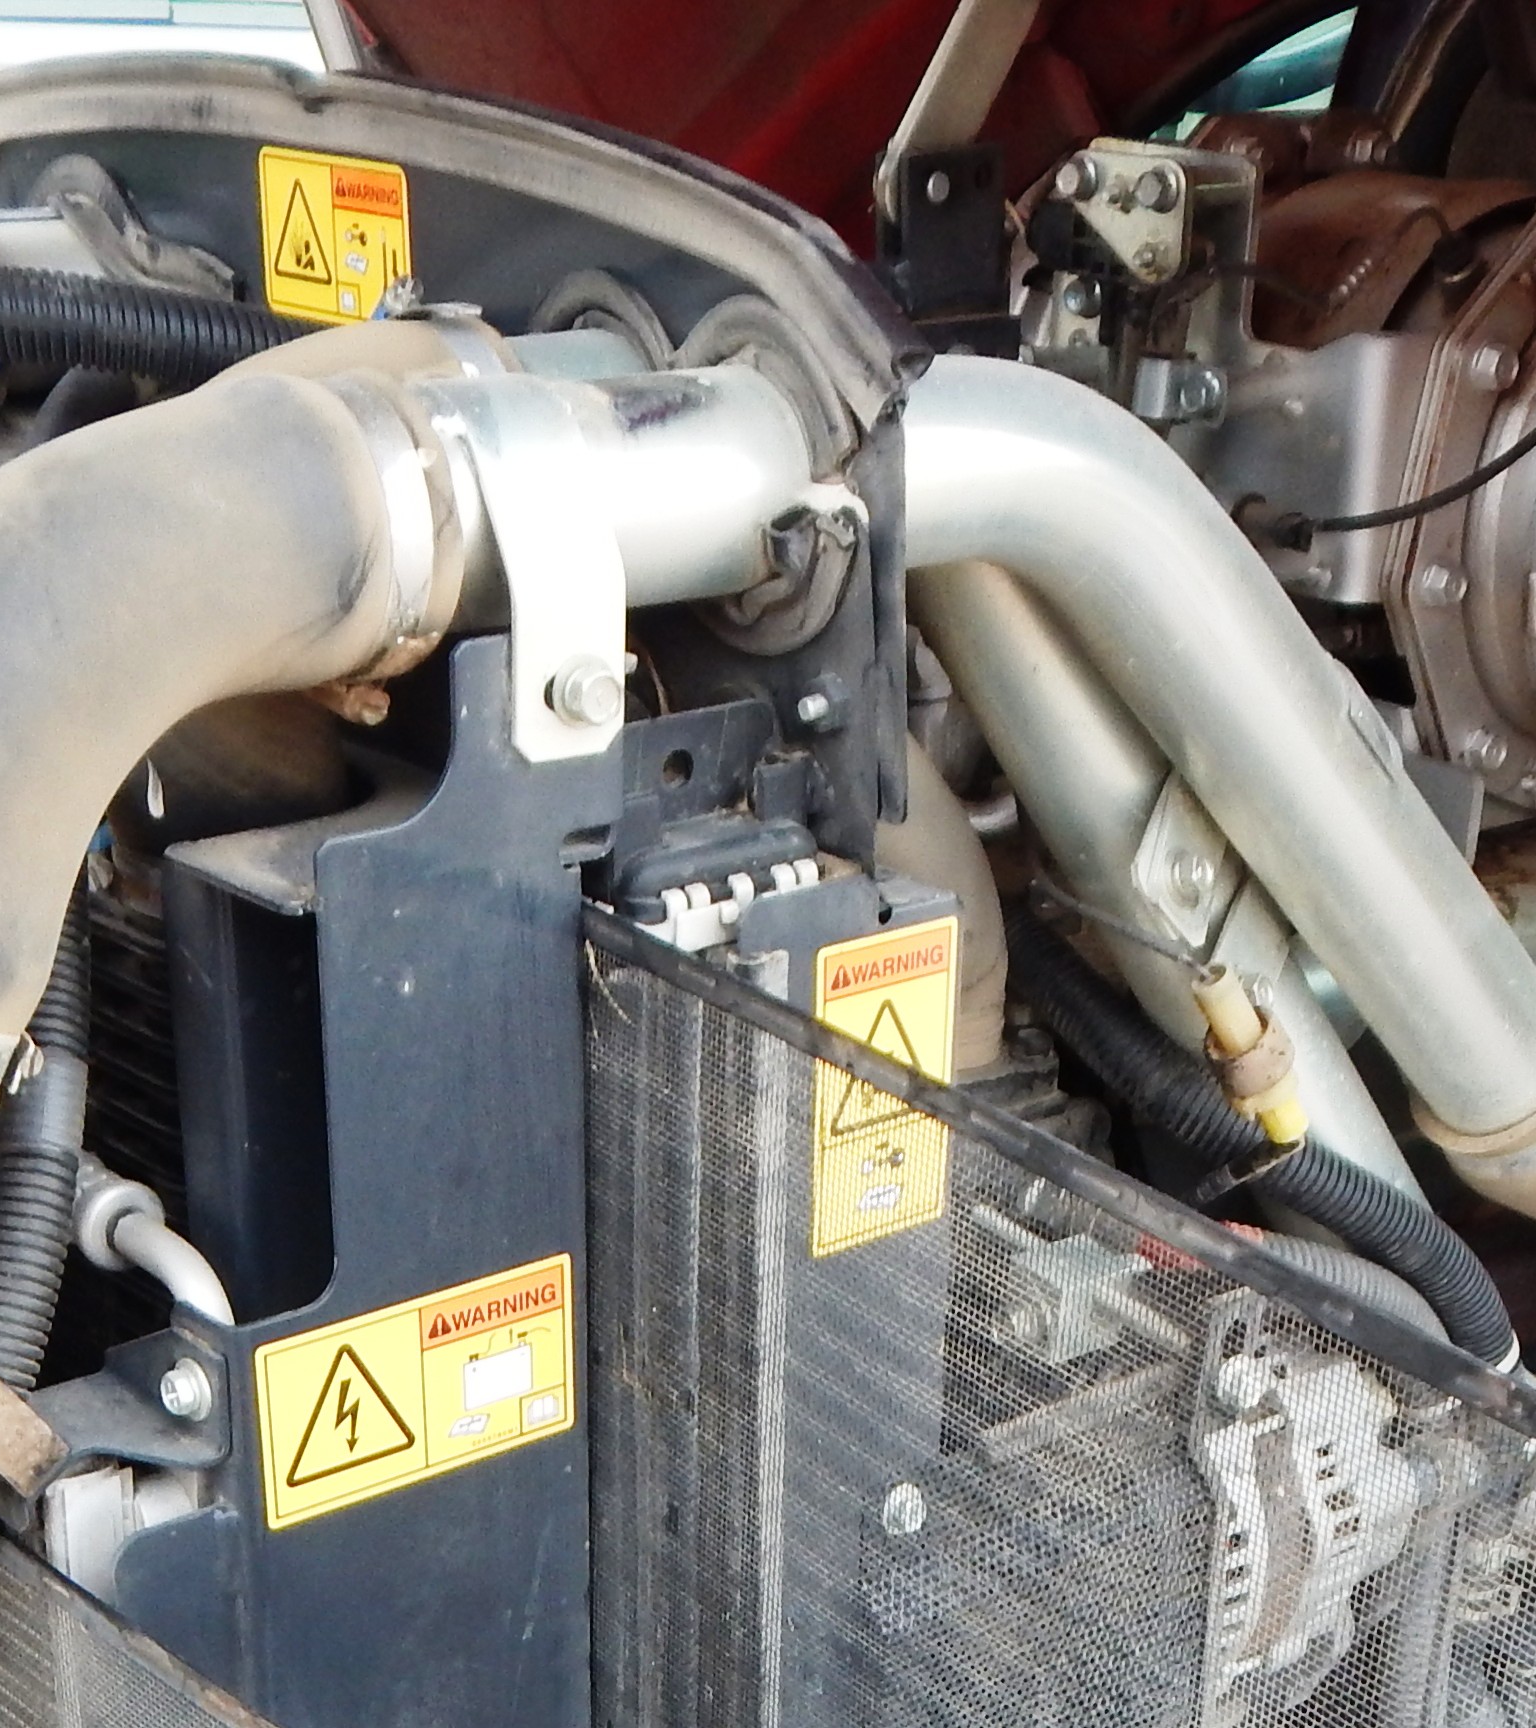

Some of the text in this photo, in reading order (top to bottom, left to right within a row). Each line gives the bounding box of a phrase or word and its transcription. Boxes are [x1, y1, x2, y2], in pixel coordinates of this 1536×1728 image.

[347, 183, 400, 206] WARNING
[852, 945, 943, 983] WARNING
[451, 1283, 556, 1331] WARNING
